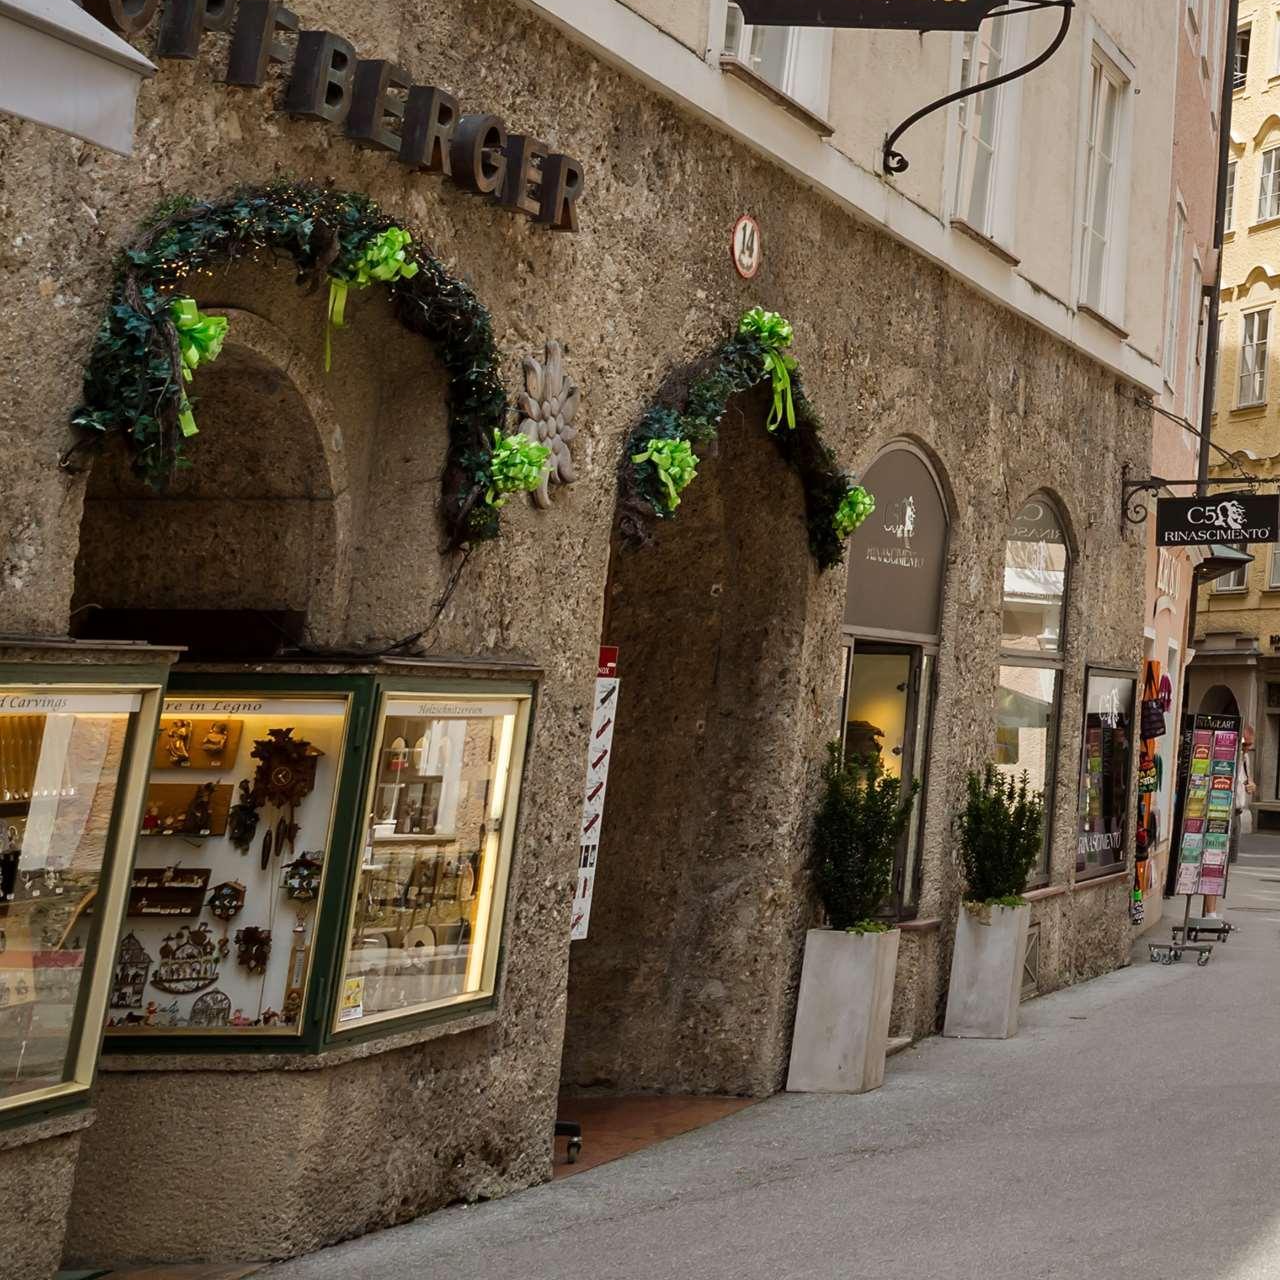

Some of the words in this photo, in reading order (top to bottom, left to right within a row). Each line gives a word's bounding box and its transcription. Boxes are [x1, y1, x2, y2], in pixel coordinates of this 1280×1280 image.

[741, 222, 755, 258] 14
[1186, 506, 1217, 524] C5
[1164, 528, 1270, 542] RINASCIMENTO
[9, 696, 67, 712] Carvings
[212, 701, 263, 715] Legno
